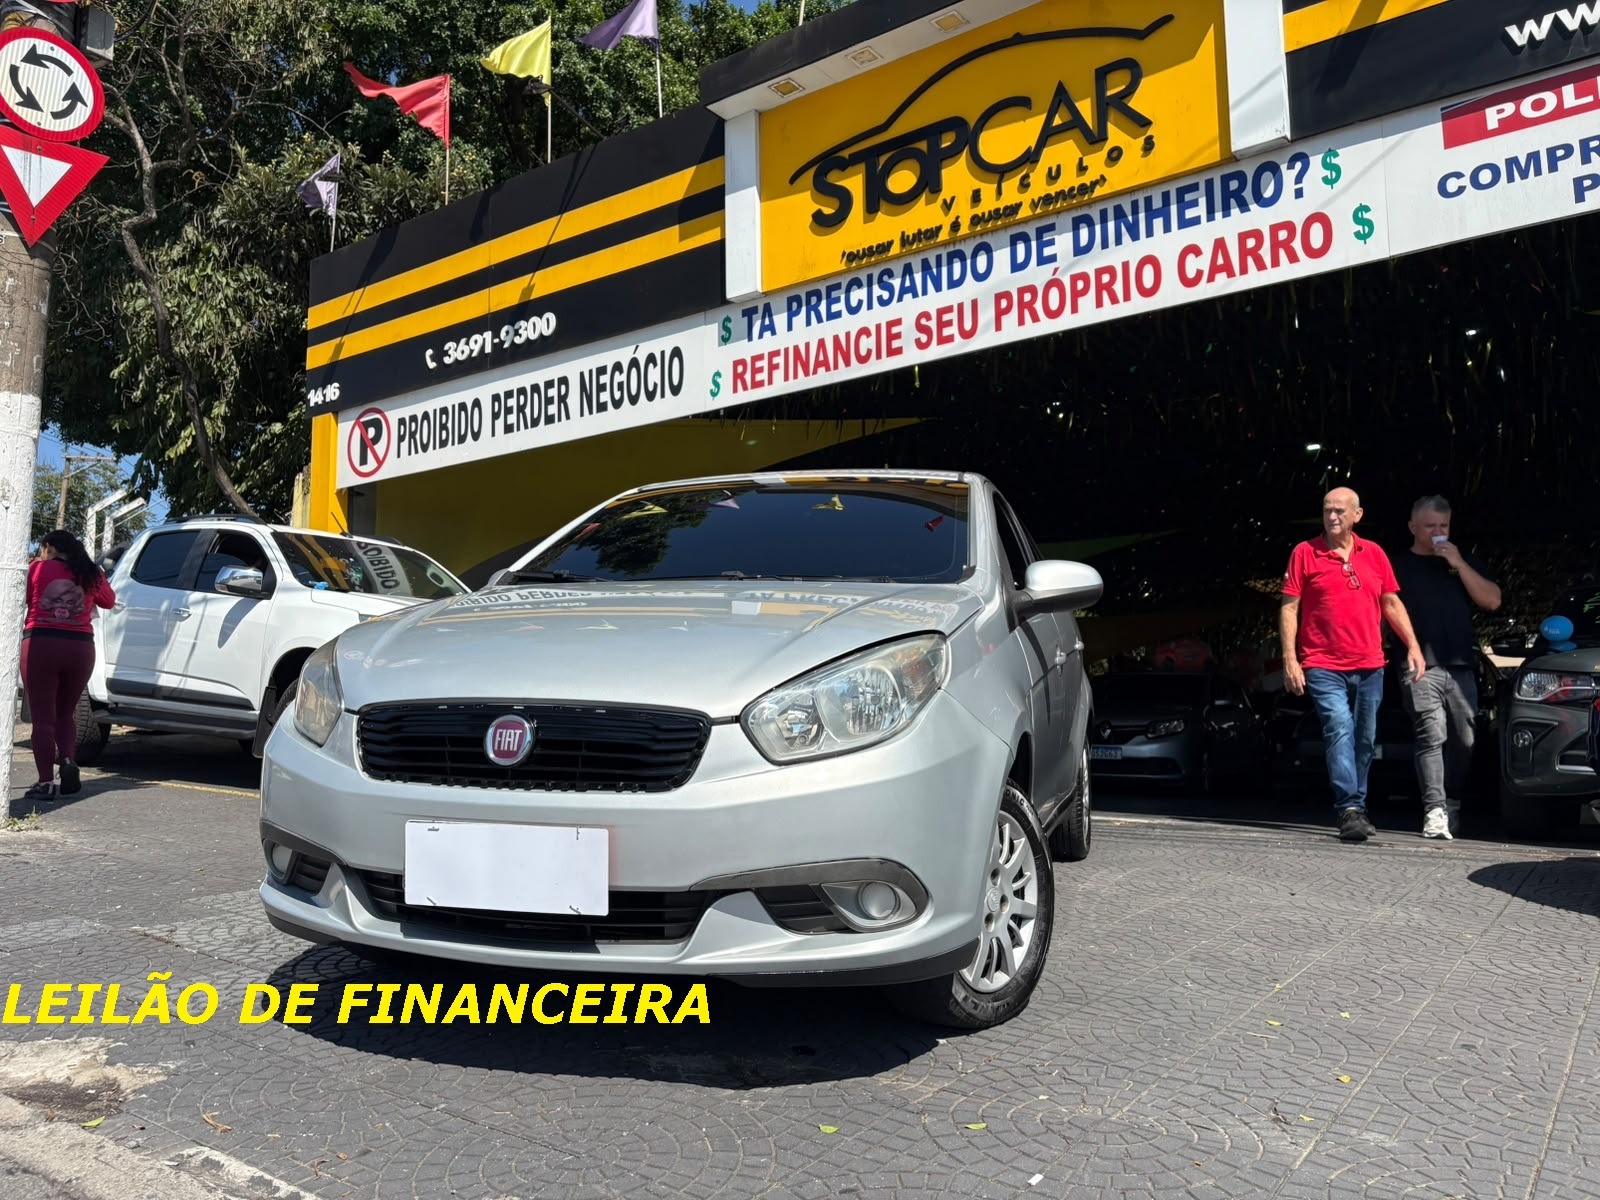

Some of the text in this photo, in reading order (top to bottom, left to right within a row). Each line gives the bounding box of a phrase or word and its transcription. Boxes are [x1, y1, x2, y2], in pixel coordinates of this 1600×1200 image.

[811, 57, 1152, 228] STOPCAR
[741, 302, 777, 343] TA
[786, 240, 995, 332] PRECISANDO
[1010, 222, 1058, 274] DE
[1072, 151, 1311, 258] DINHEIRO?
[900, 222, 942, 246] lutar
[950, 215, 962, 233] é
[970, 199, 1023, 227] ousar
[443, 311, 557, 366] 3691-9300
[732, 310, 903, 394] REFINANCIE
[913, 300, 980, 351] SEU
[1000, 253, 1163, 328] PRÓPRIO
[1177, 211, 1334, 288] CARRO
[307, 382, 340, 407] 1416
[397, 344, 684, 459] PROIBIDO PERDER NEGÓCIO
[494, 729, 523, 752] FIAT
